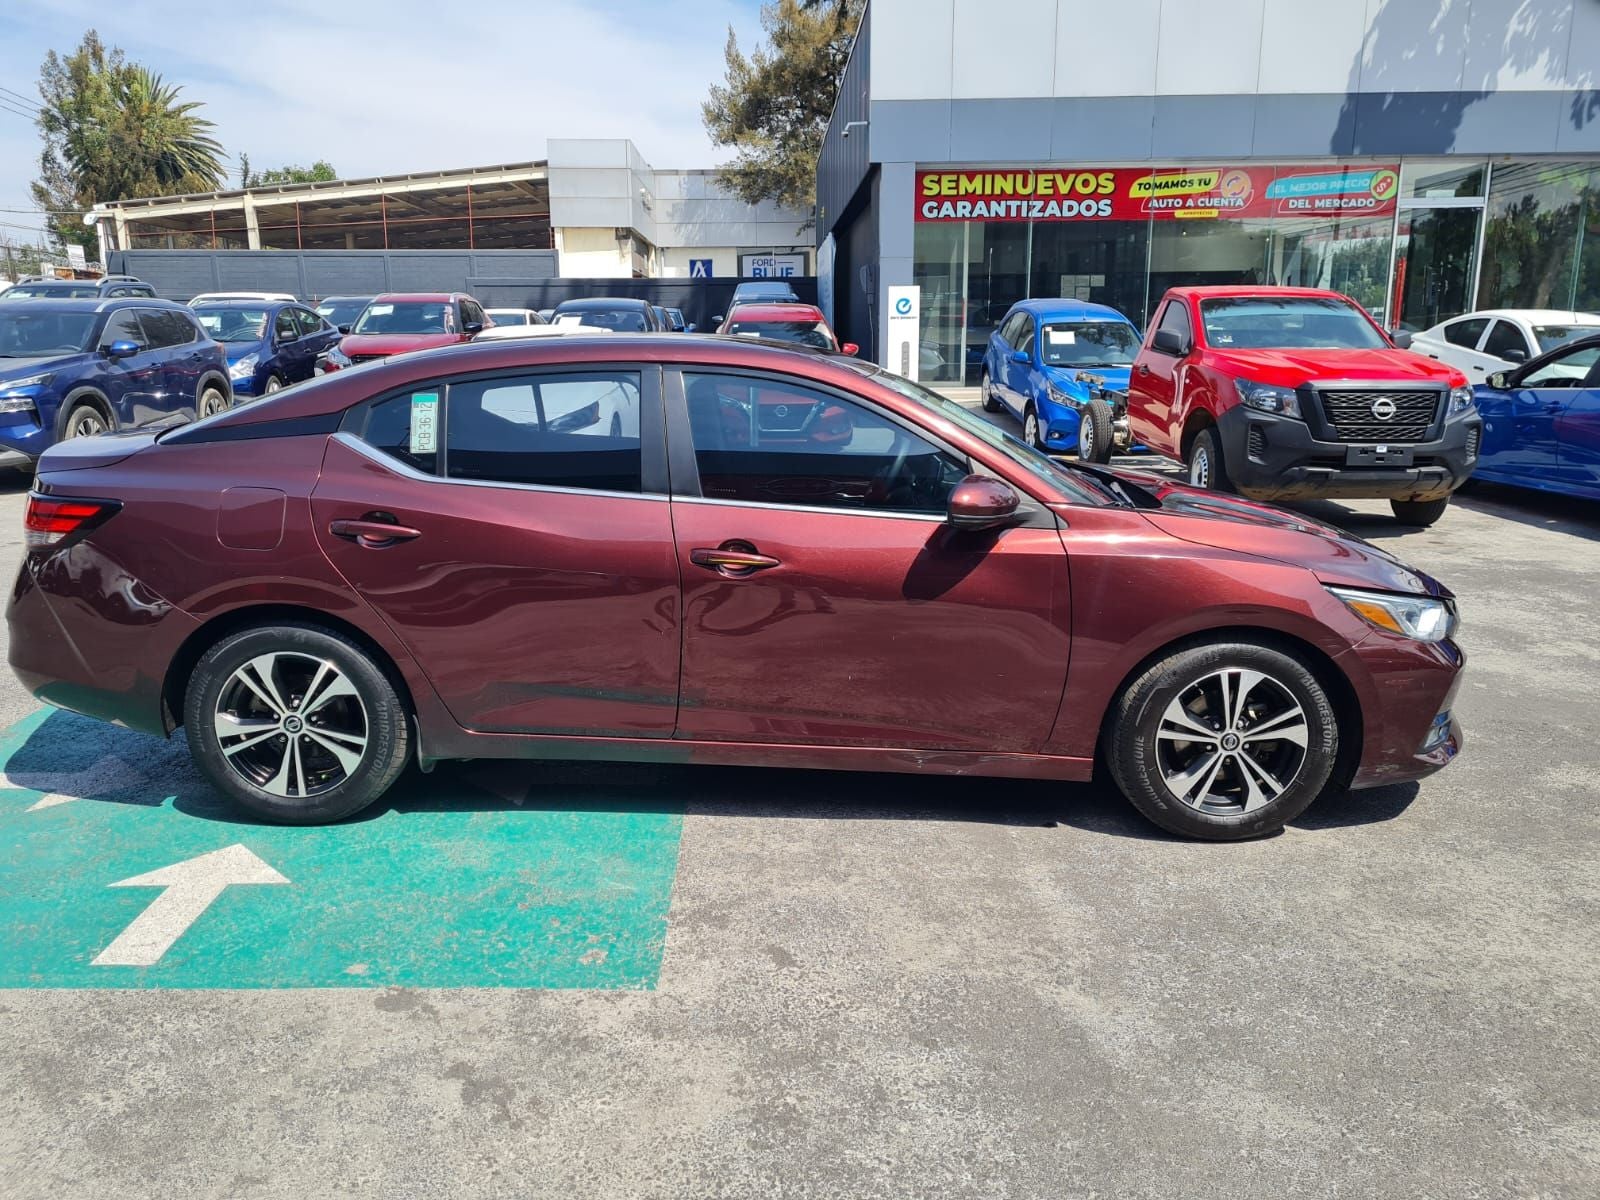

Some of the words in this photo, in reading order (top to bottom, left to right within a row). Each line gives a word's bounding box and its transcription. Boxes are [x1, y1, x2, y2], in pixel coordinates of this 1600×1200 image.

[922, 172, 1115, 197] SEMINUEVOS
[1137, 179, 1194, 191] TOMAMOS
[1197, 178, 1211, 187] TU
[1275, 184, 1287, 194] EL
[1289, 182, 1329, 192] MEJOR
[1330, 179, 1370, 190] PRECIO
[922, 199, 1112, 219] GARANTIZADOS
[1148, 198, 1182, 208] AUTO
[1185, 198, 1194, 207] A
[1197, 197, 1244, 207] CUENTA
[1288, 199, 1312, 208] DEL
[1314, 198, 1375, 208] MERCADO
[752, 258, 776, 267] FORD
[1301, 674, 1333, 754] BRIDGESTONE
